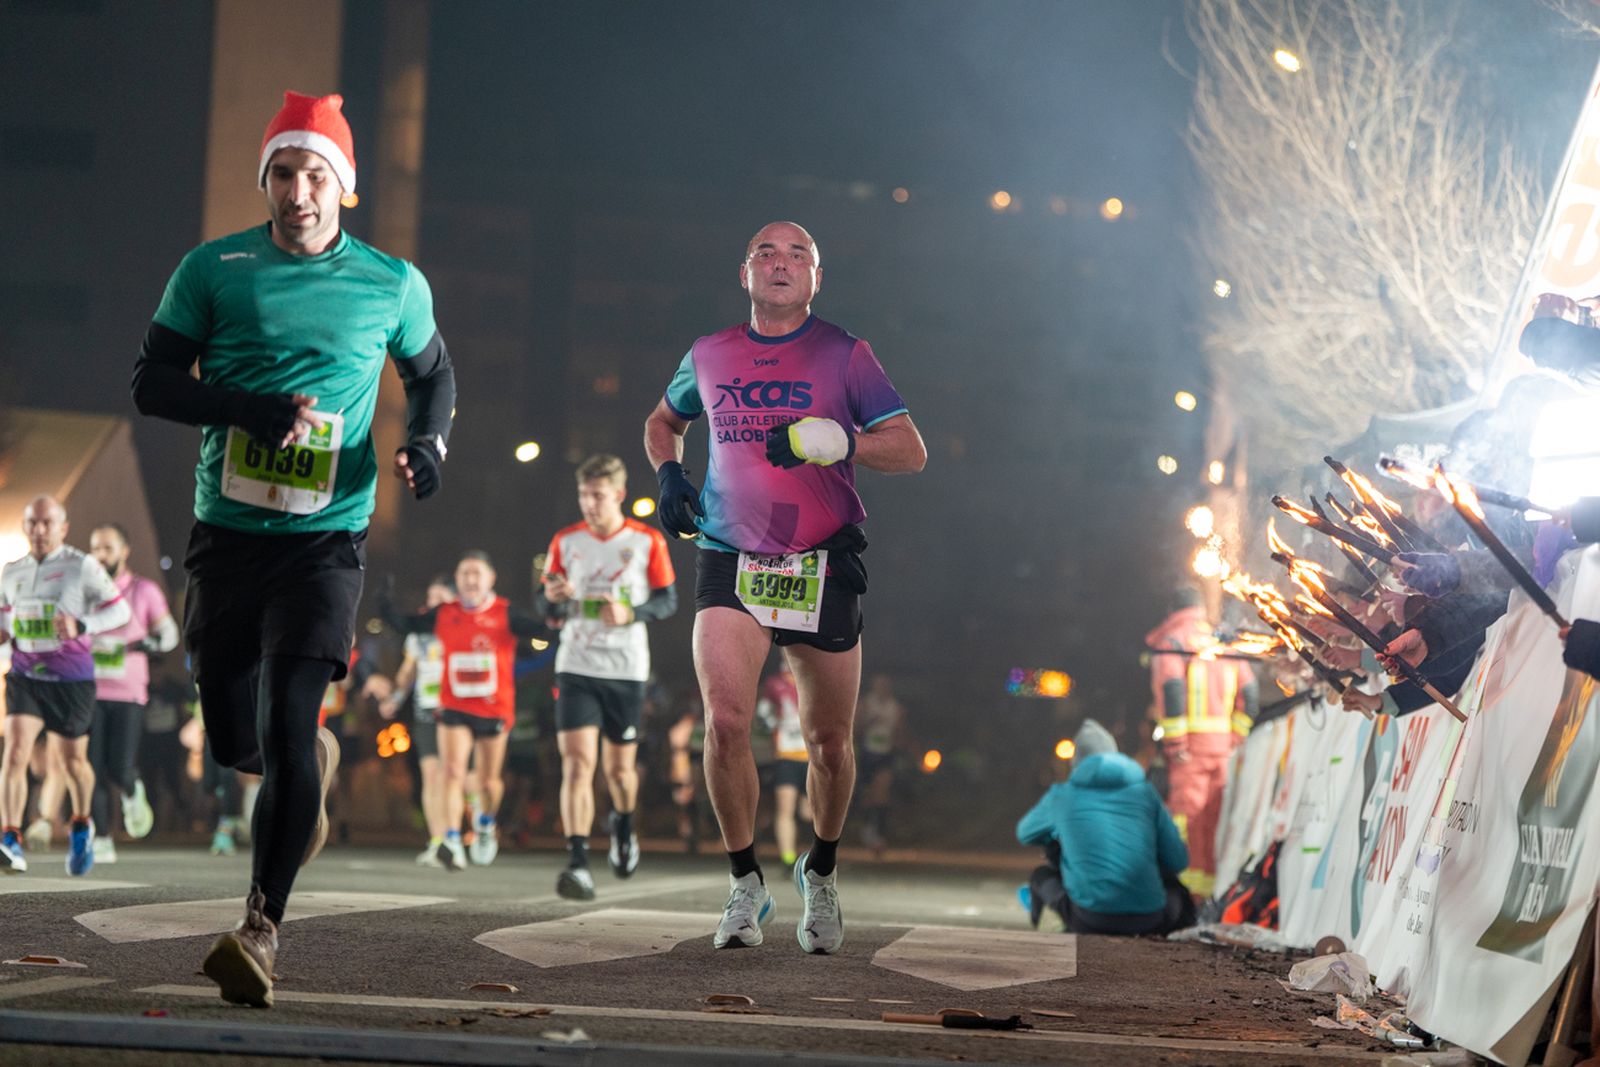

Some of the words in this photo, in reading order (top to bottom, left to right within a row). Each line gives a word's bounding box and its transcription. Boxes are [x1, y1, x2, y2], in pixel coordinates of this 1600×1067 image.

[714, 415, 739, 428] CLUB
[741, 415, 802, 427] ATLETISM
[245, 440, 315, 478] 6139
[751, 572, 806, 602] 5999
